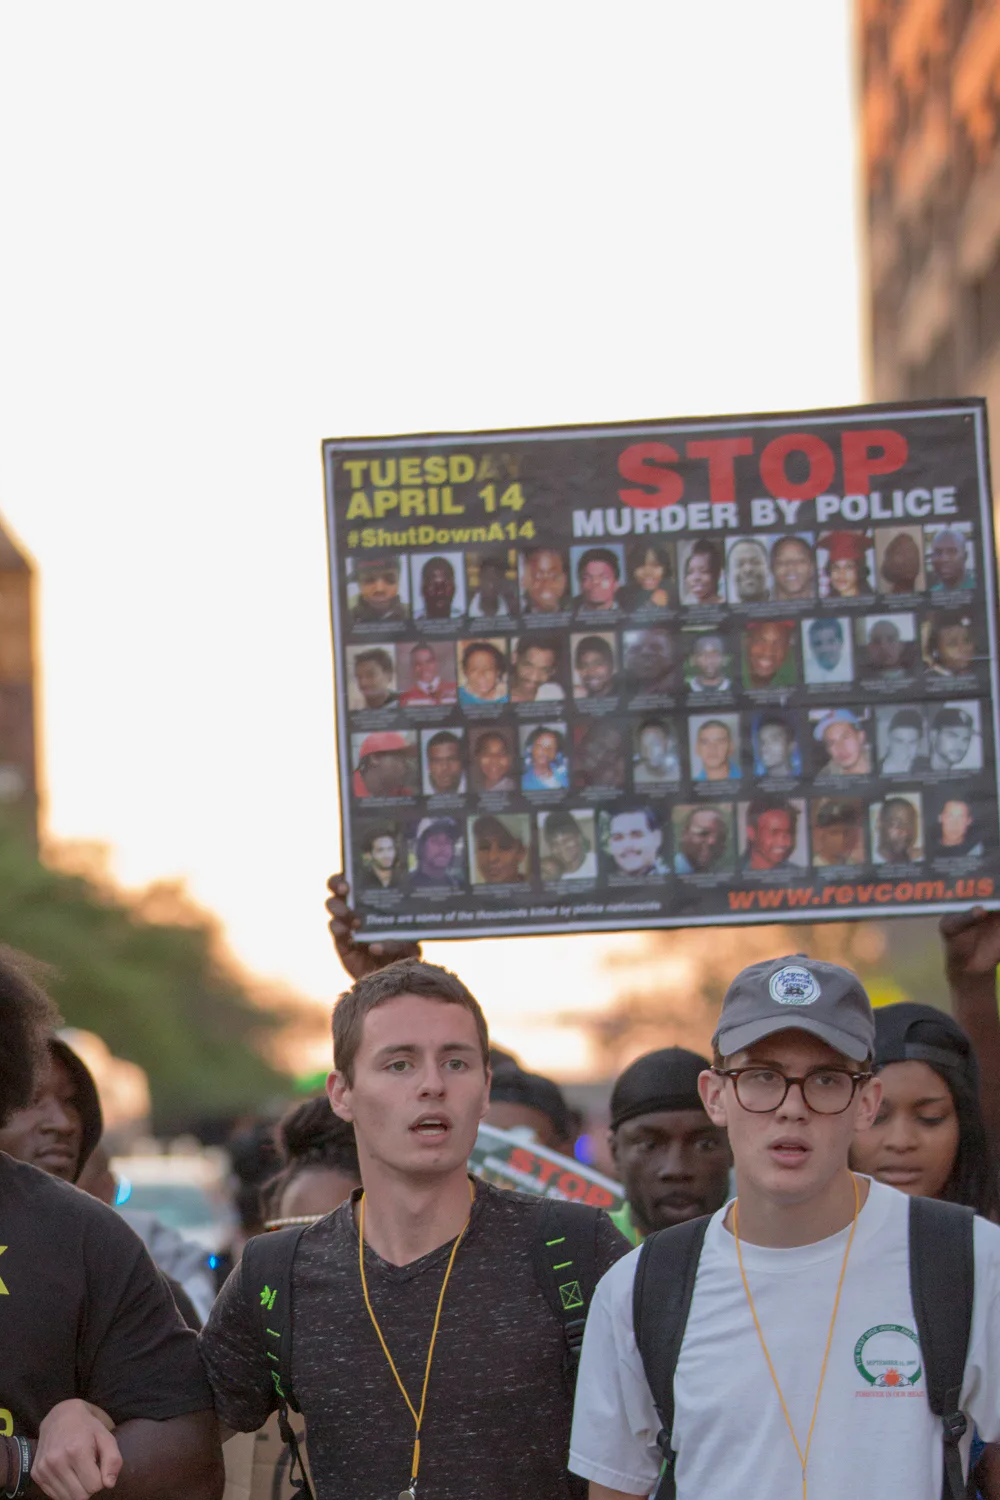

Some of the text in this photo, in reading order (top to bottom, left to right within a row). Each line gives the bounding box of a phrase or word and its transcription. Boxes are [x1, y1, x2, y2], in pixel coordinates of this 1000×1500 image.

[617, 429, 909, 510] STOP
[346, 483, 526, 519] APRIL 14
[572, 486, 958, 537] MURDER BY POLICE
[347, 520, 536, 549] #ShutDownA14
[728, 876, 995, 910] www.revcom.us
[508, 1147, 615, 1207] STOP
